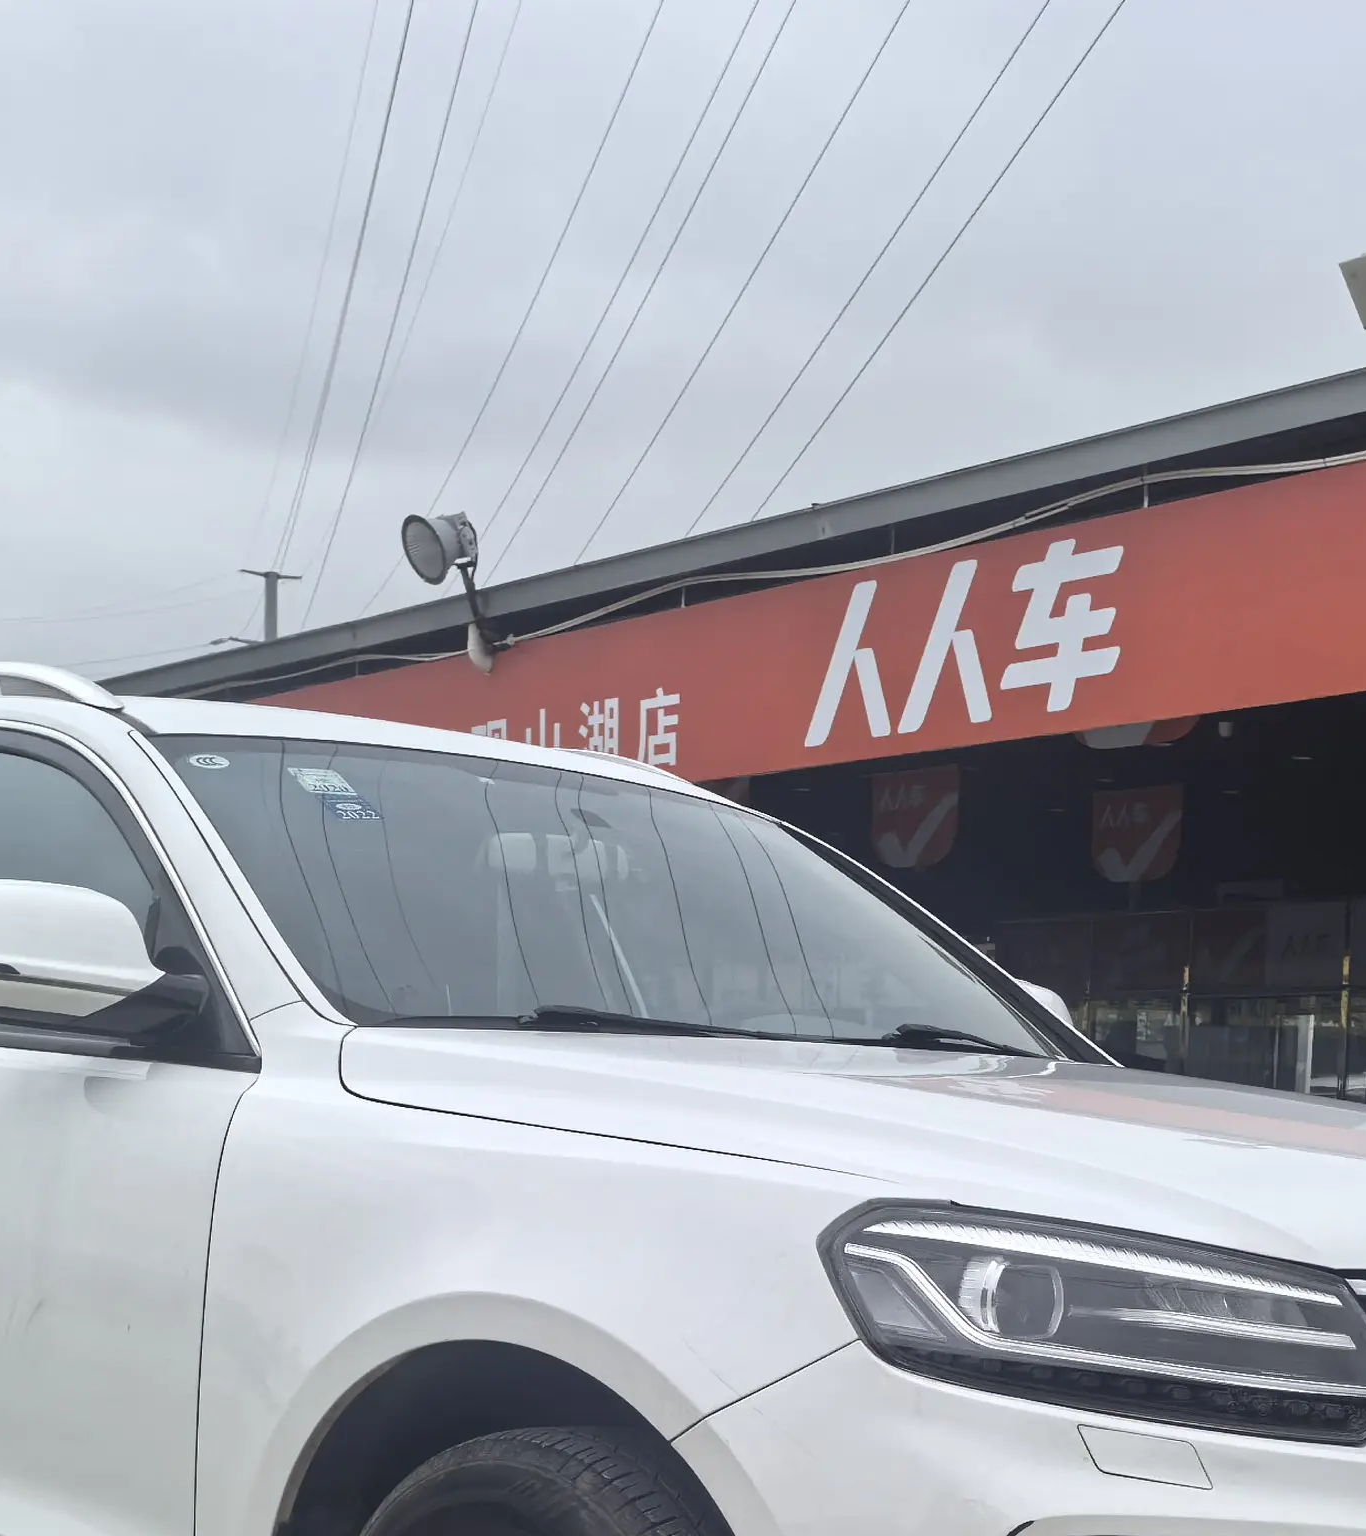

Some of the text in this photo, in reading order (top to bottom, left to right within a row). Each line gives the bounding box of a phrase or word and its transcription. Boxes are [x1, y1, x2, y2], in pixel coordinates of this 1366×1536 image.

[804, 539, 1124, 748] 人人车
[471, 687, 680, 766] 山湖店
